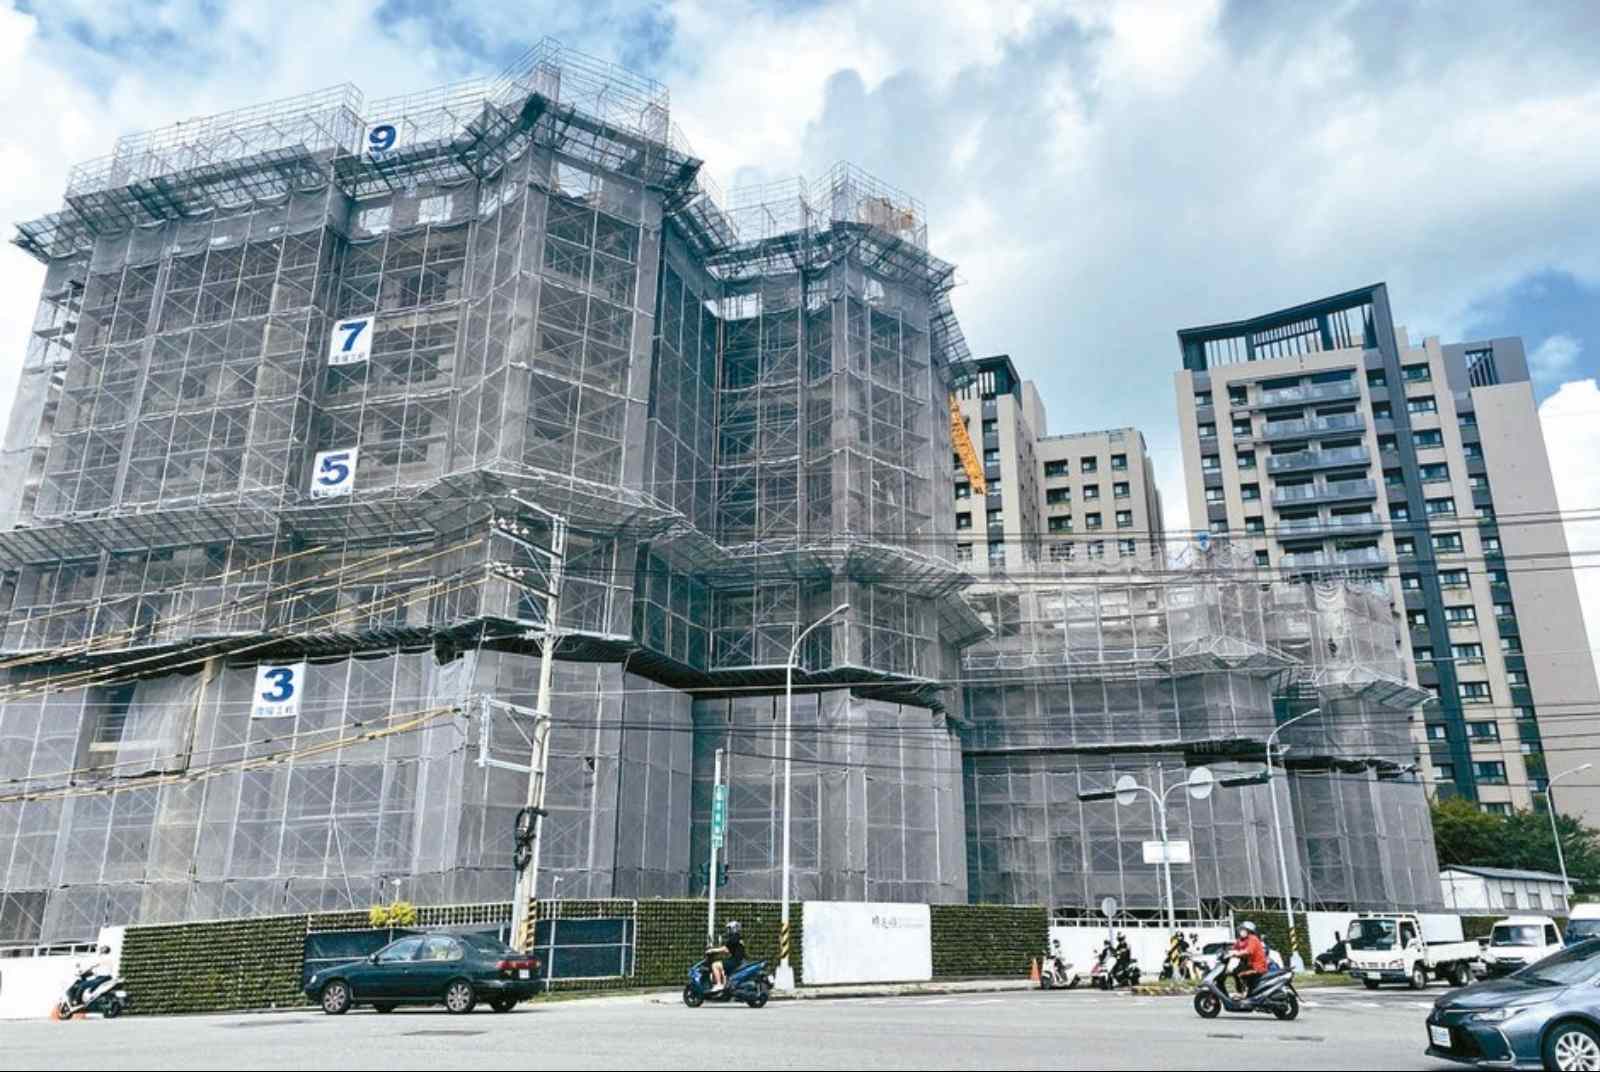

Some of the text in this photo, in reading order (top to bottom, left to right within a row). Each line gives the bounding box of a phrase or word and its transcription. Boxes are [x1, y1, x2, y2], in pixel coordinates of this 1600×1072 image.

[369, 125, 396, 152] 9
[339, 321, 368, 352] 7
[318, 453, 350, 486] 5
[262, 668, 294, 702] 3
